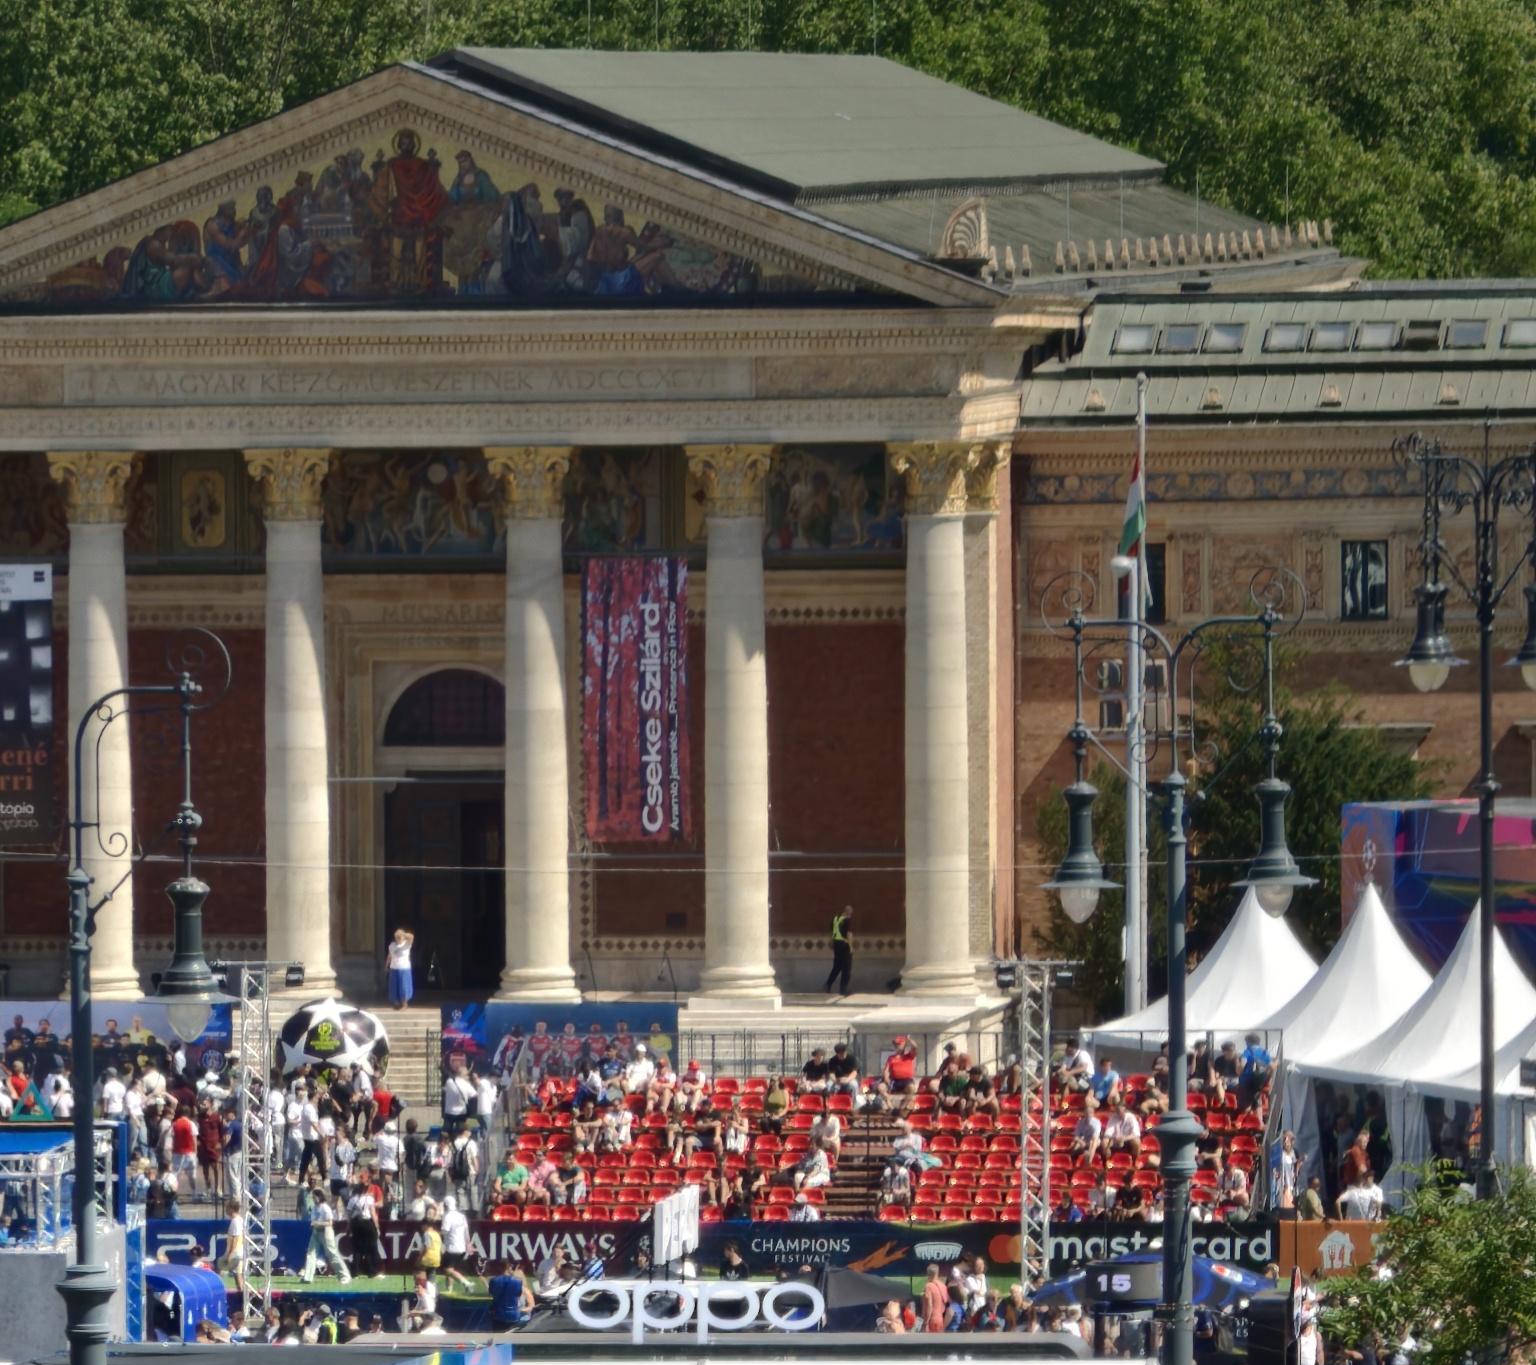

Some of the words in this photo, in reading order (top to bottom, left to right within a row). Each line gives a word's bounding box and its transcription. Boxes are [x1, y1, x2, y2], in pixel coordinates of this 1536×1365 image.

[137, 373, 246, 395] MAGYAR
[639, 601, 662, 712] Szilárd
[641, 717, 663, 832] Cseke
[751, 1238, 852, 1255] CHAMPIONS
[1097, 1273, 1132, 1293] 15
[566, 1281, 825, 1345] oppo
